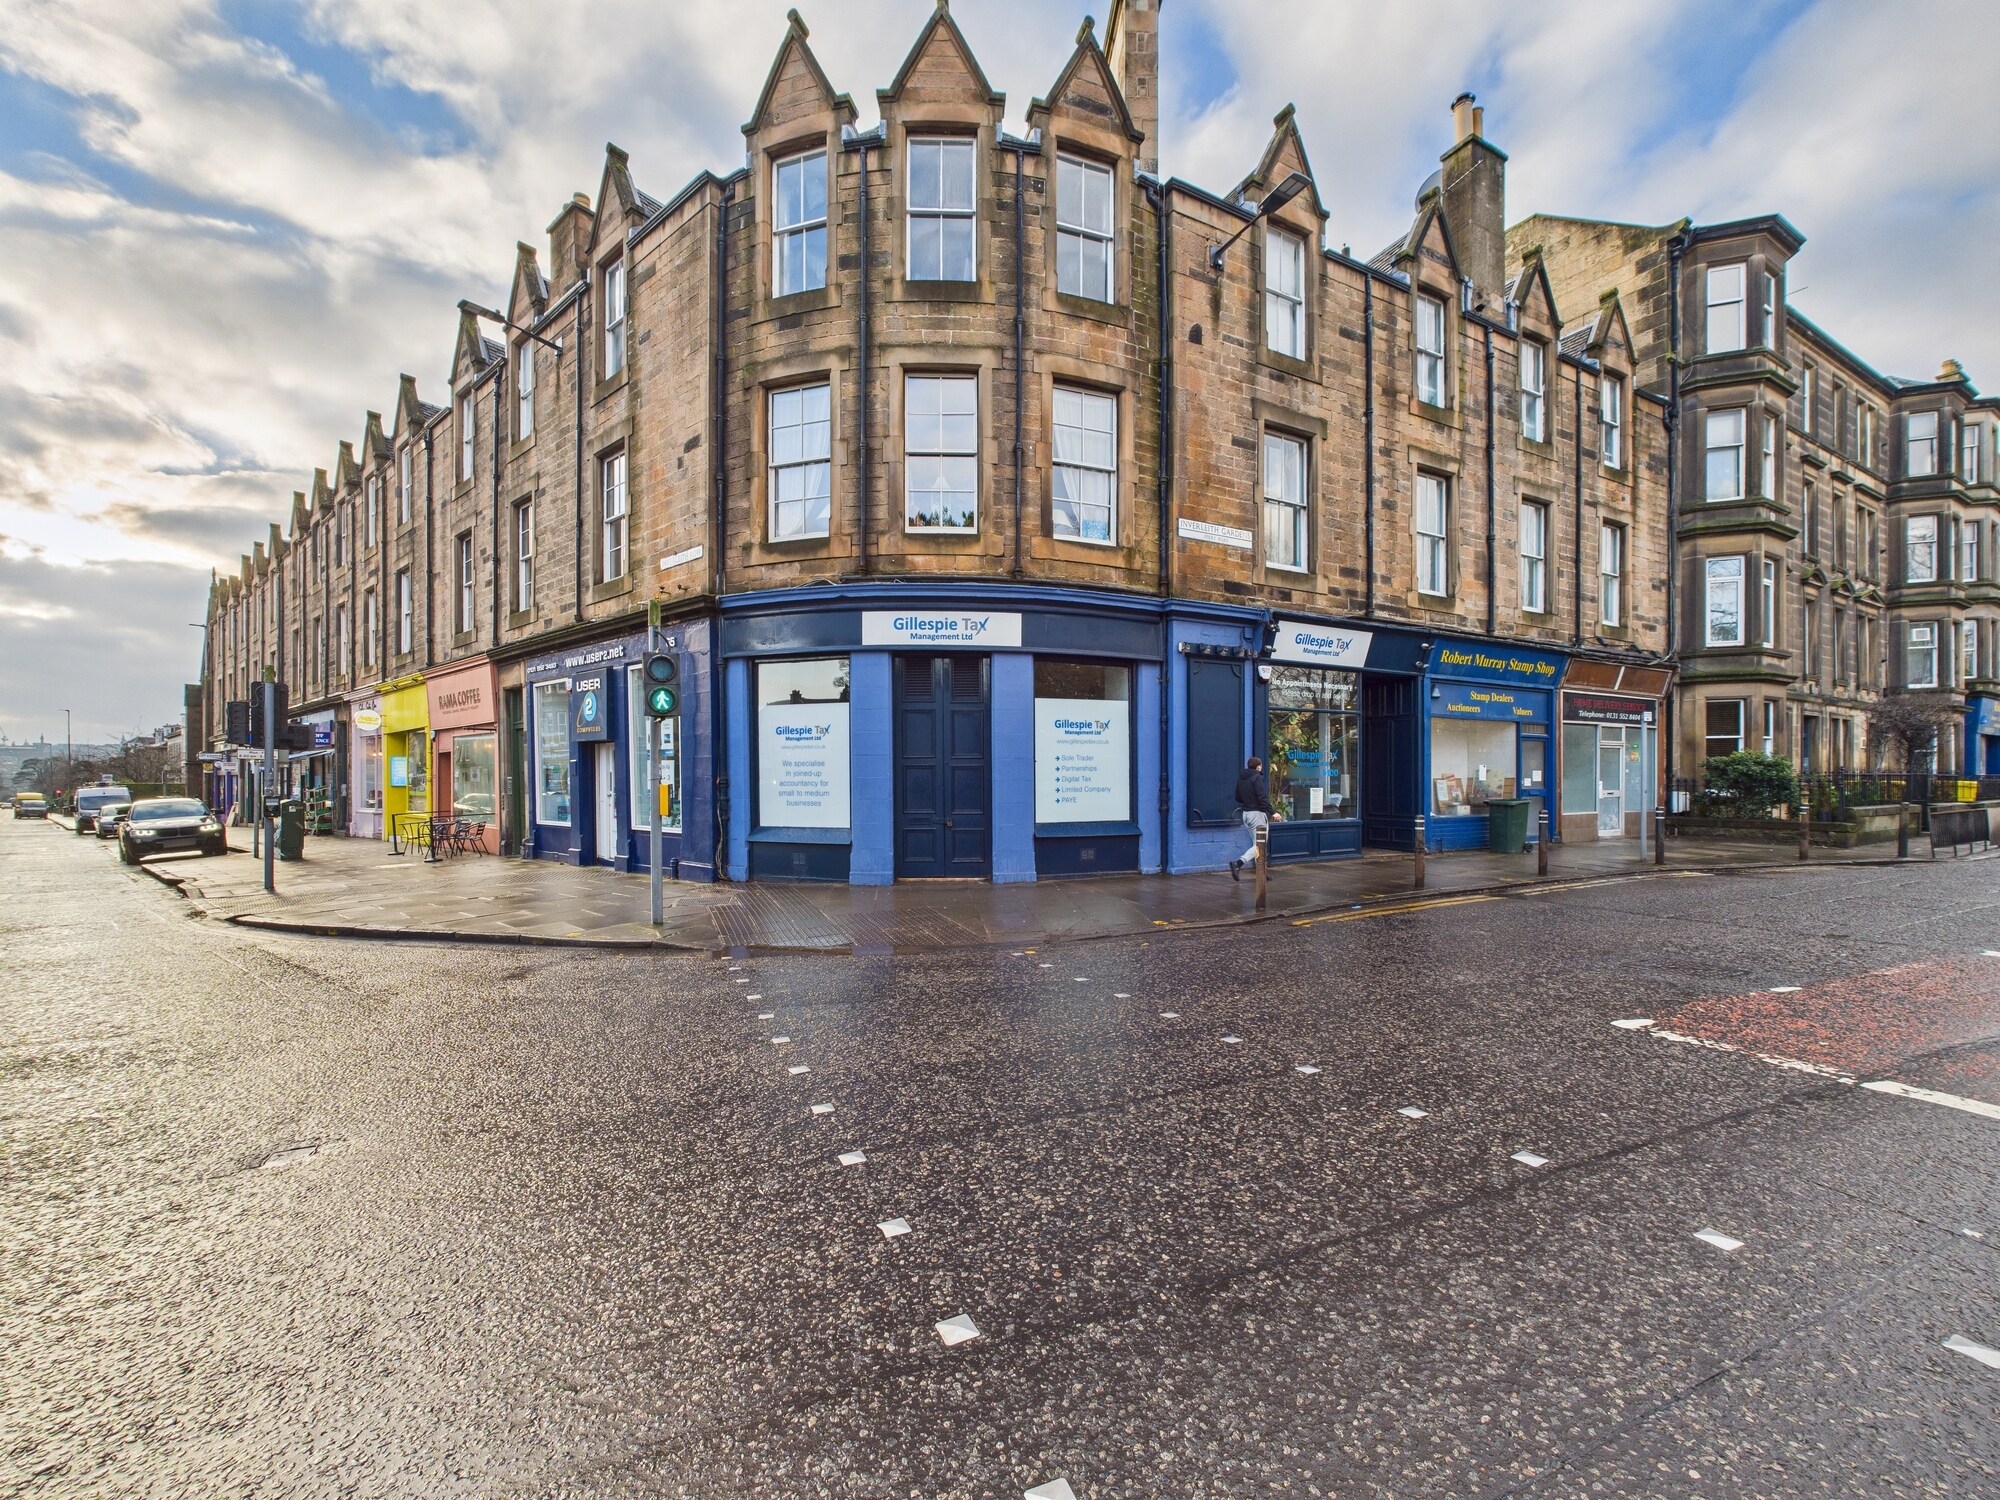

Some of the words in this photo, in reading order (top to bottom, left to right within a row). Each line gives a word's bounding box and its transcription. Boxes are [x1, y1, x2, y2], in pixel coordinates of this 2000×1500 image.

[1181, 520, 1219, 533] INVERLEITH
[1221, 527, 1250, 540] GARDENS
[894, 617, 958, 633] Gillespie
[962, 616, 990, 636] Tax
[910, 633, 960, 641] Management
[1295, 633, 1334, 649] Gillespie
[1336, 638, 1354, 653] Tax
[565, 644, 624, 667] www.user2.net
[1302, 648, 1332, 656] Management
[1440, 650, 1473, 666] Robert
[1473, 654, 1508, 672] Murray
[1508, 658, 1534, 675] Stamp
[1535, 662, 1556, 677] Shop
[576, 678, 600, 692] USER
[1282, 678, 1322, 688] Appointments
[1324, 682, 1353, 692] Necessary
[438, 692, 458, 710] RAMA
[458, 688, 480, 706] COFFEE
[1470, 690, 1490, 704] Stamp
[1491, 692, 1514, 703] Dealers
[586, 698, 592, 714] 2
[1446, 703, 1480, 713] Auctioneers
[1512, 706, 1533, 716] Valuers
[1594, 700, 1622, 710] DELIVERY
[1622, 702, 1646, 712] SERVICE
[776, 726, 812, 736] Gillespie
[814, 724, 831, 737] Tax
[1054, 720, 1092, 730] Gillespie
[1094, 720, 1110, 732] Tax
[1288, 749, 1322, 761] Gillespie
[794, 760, 826, 768] specialise
